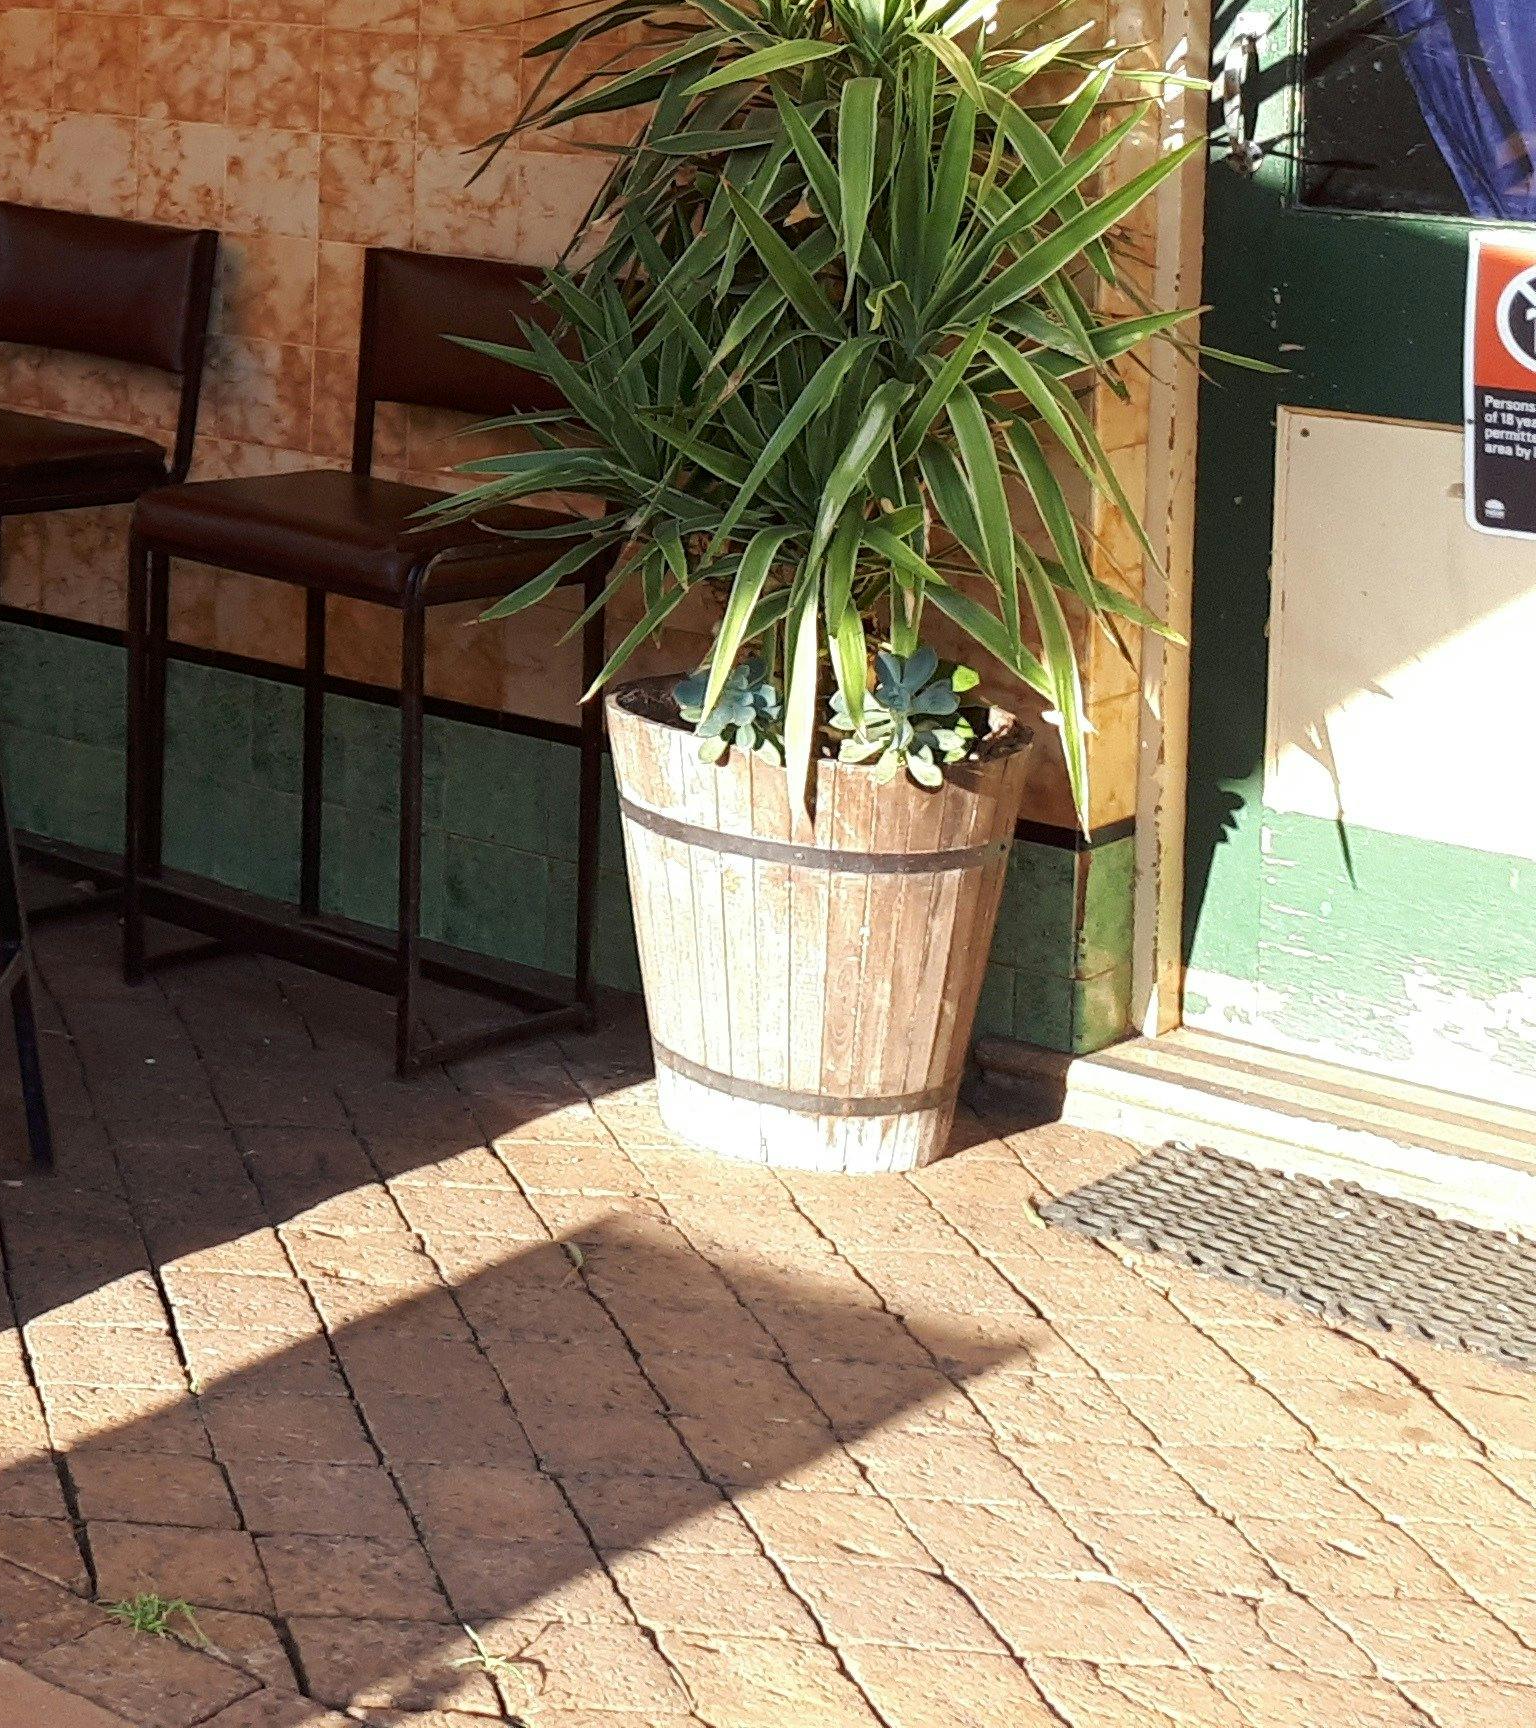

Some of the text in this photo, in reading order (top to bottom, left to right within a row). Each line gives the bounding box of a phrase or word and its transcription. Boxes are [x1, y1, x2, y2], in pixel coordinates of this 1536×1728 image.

[1484, 395, 1536, 413] Persons
[1484, 411, 1498, 424] of
[1501, 413, 1514, 426] 18
[1484, 443, 1513, 456] area
[1515, 444, 1531, 461] by
